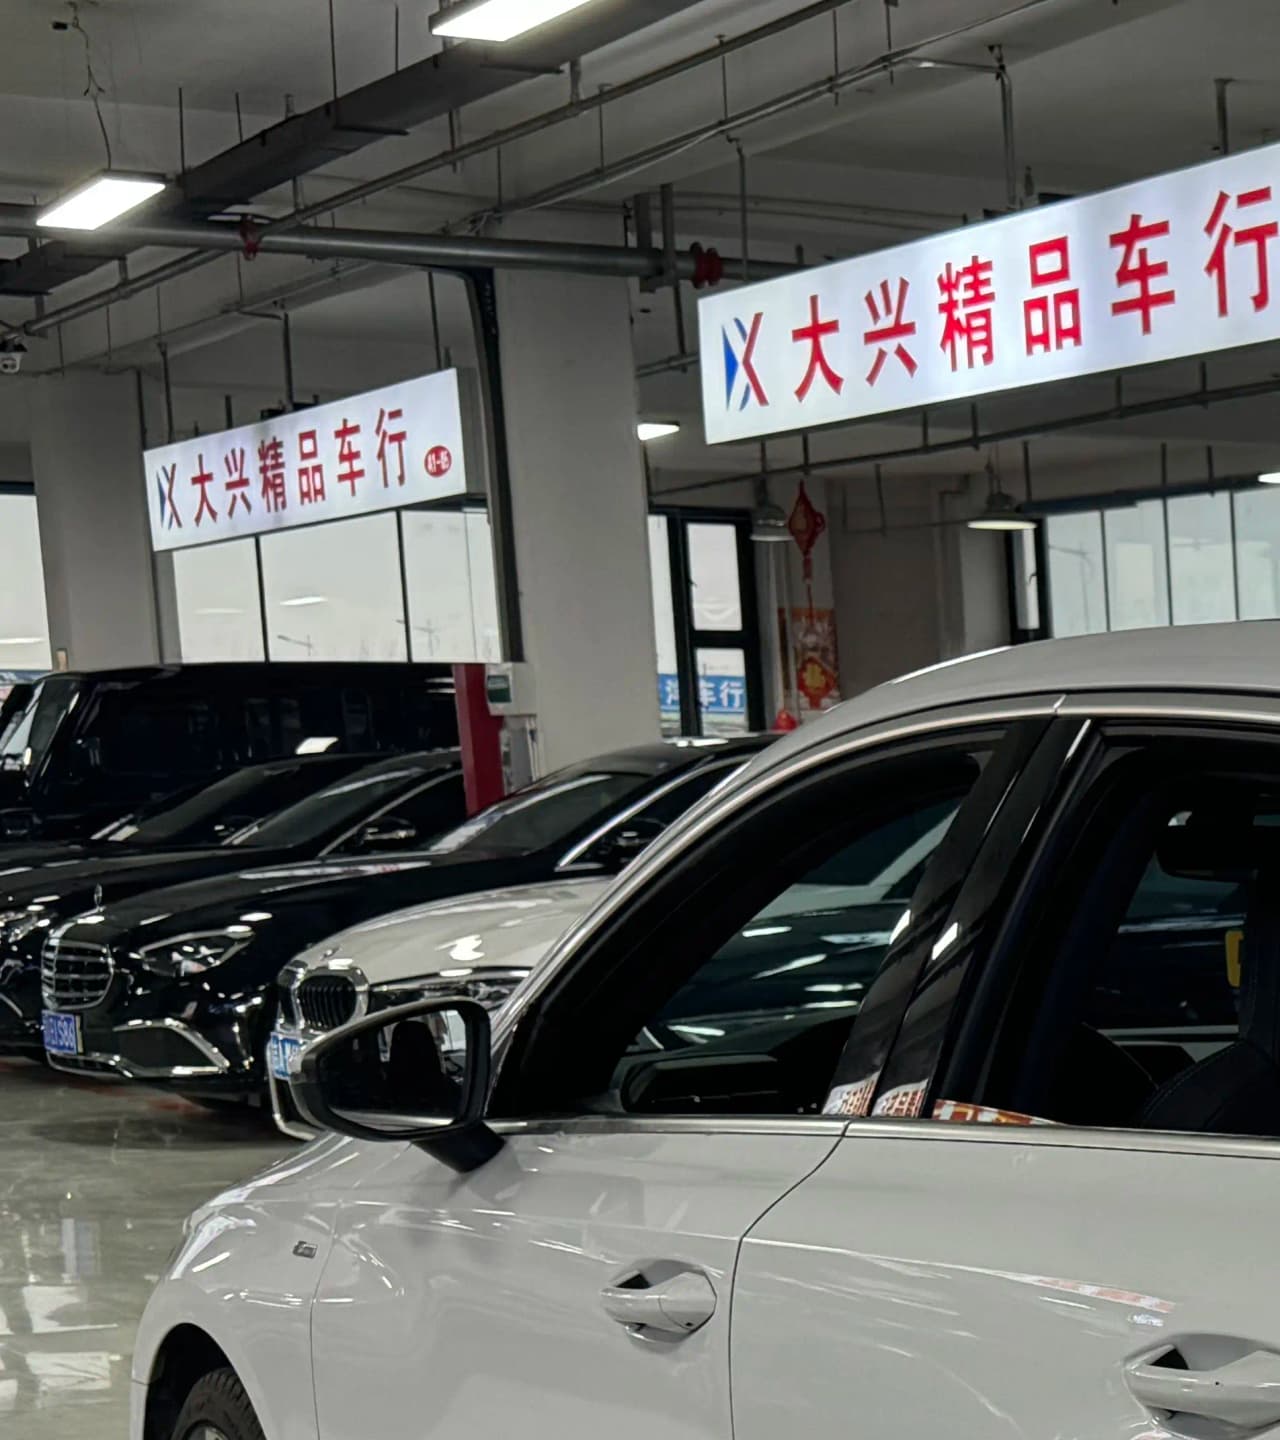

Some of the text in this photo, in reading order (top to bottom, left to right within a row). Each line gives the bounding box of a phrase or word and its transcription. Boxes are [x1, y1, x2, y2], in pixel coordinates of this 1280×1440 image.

[792, 185, 1280, 402] 大兴精品车行
[191, 407, 407, 528] 大兴精品车行
